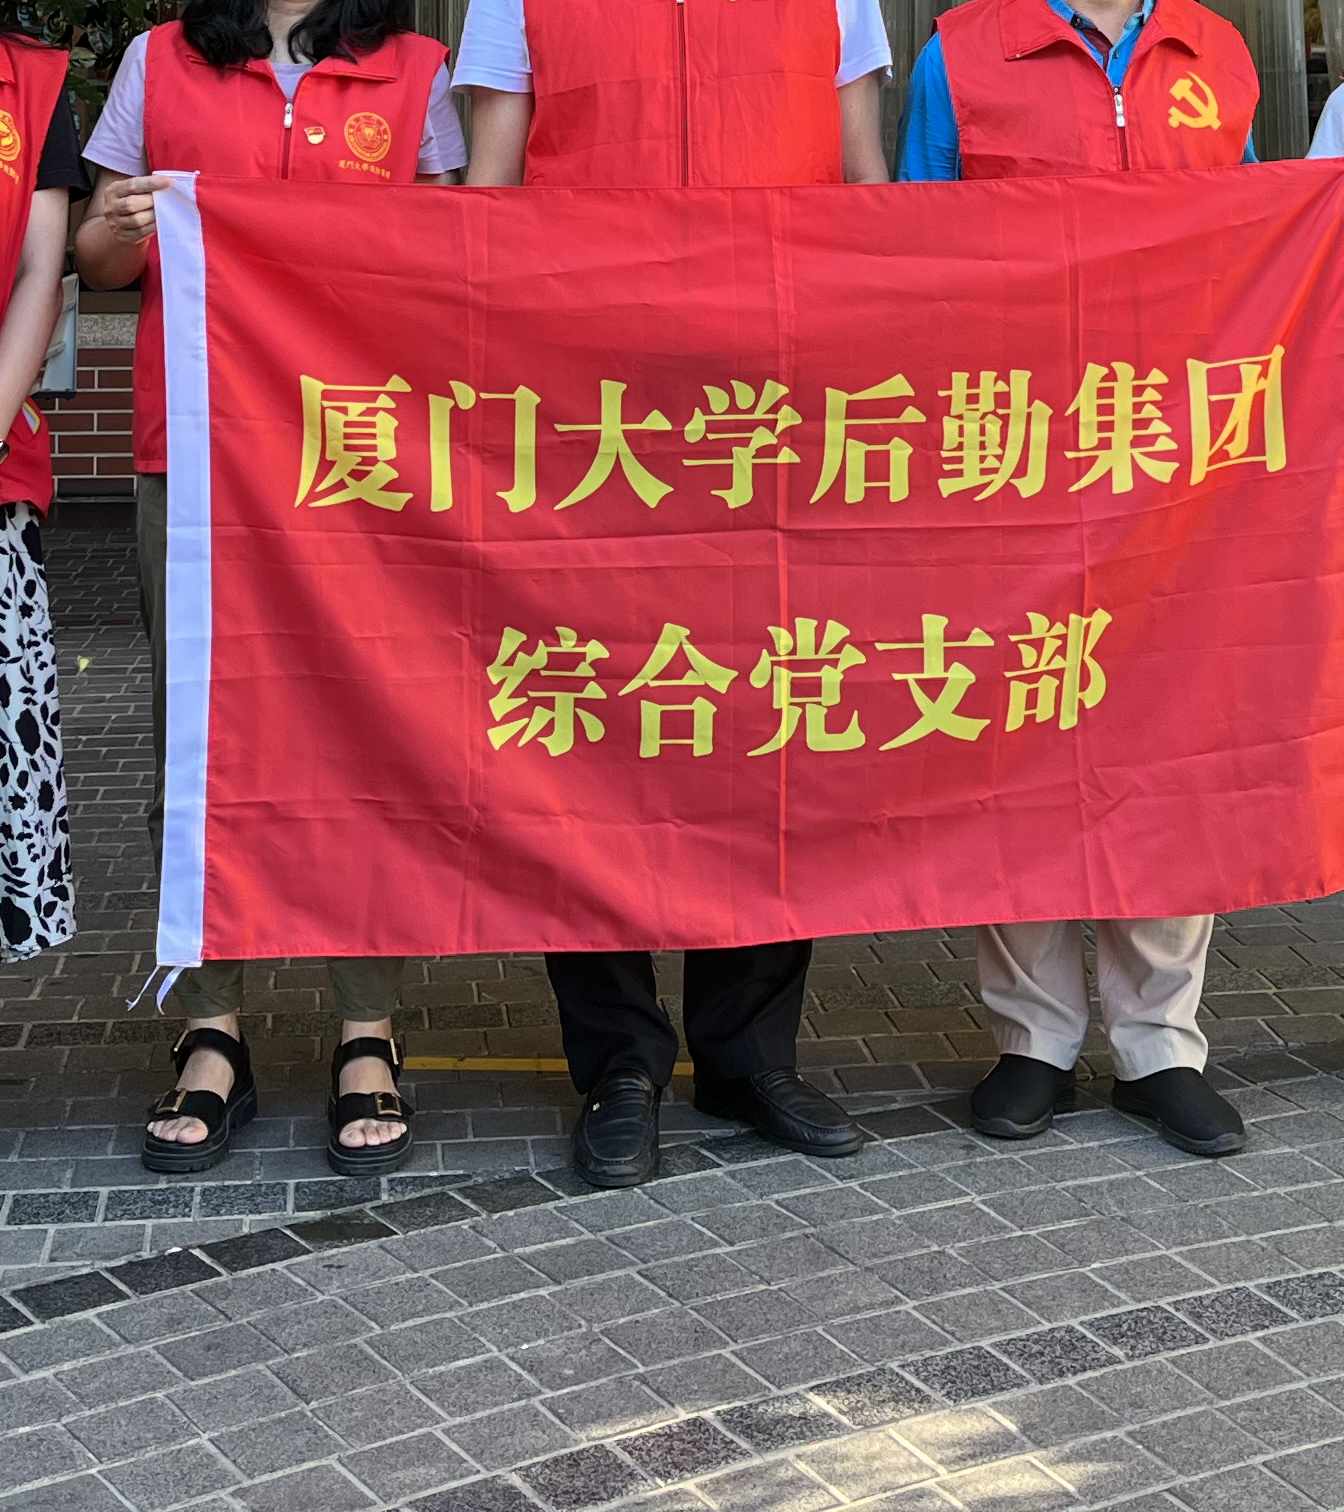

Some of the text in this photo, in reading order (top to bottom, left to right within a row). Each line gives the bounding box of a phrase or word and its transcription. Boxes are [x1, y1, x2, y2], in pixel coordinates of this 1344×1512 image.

[294, 345, 1286, 513] 厦门大学后勤集团
[485, 609, 1113, 758] 综合党支部
